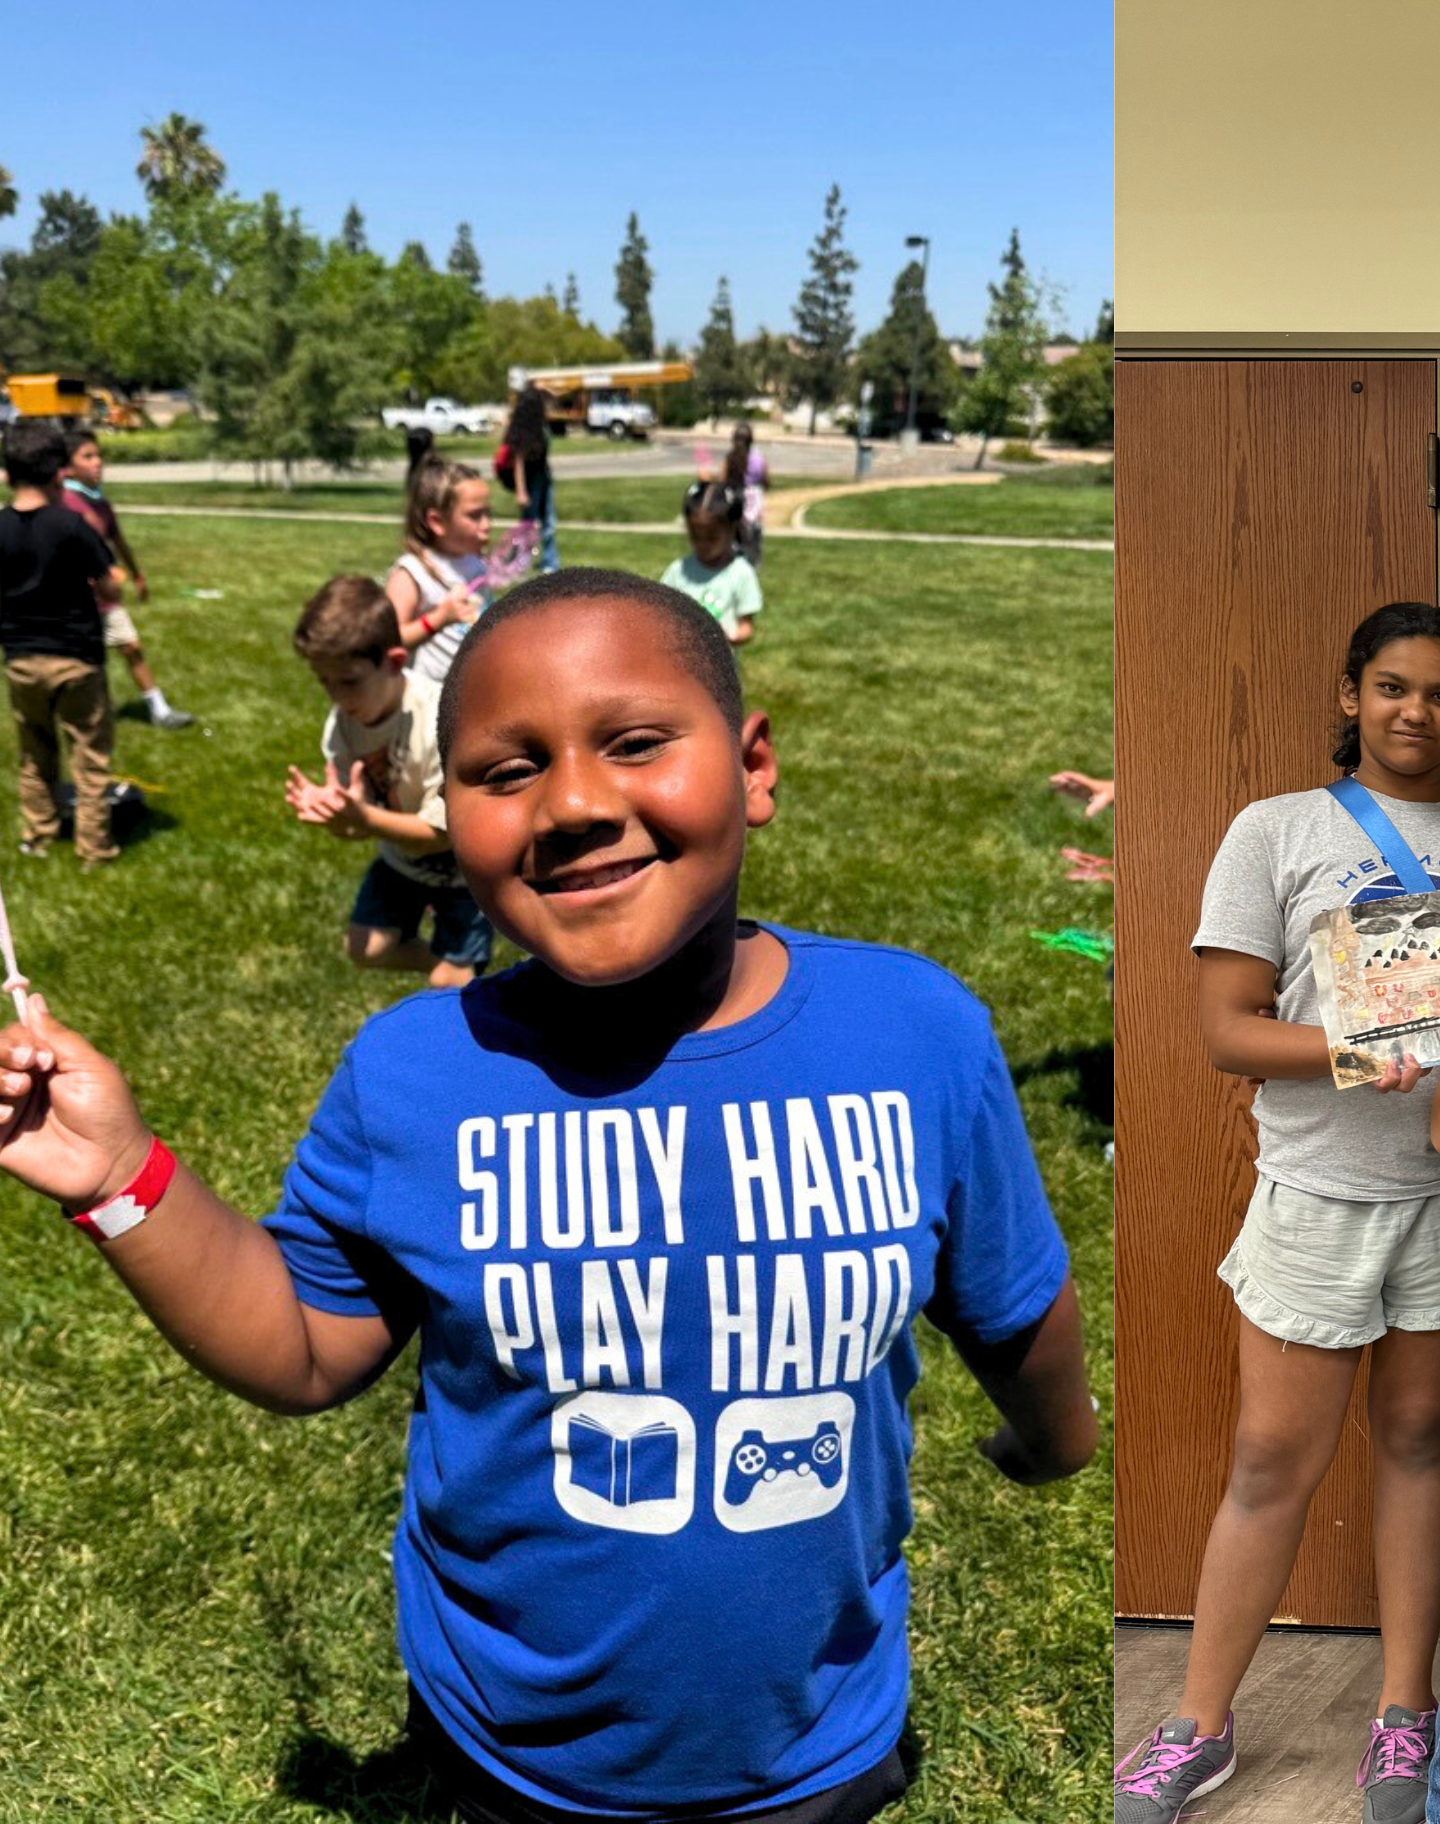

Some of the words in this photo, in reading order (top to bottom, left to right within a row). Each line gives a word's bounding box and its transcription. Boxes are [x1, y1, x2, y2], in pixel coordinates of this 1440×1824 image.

[456, 1105, 687, 1251] STUDY
[723, 1090, 921, 1242] HARD
[483, 1256, 668, 1393] PLAY
[706, 1243, 913, 1393] HARD
